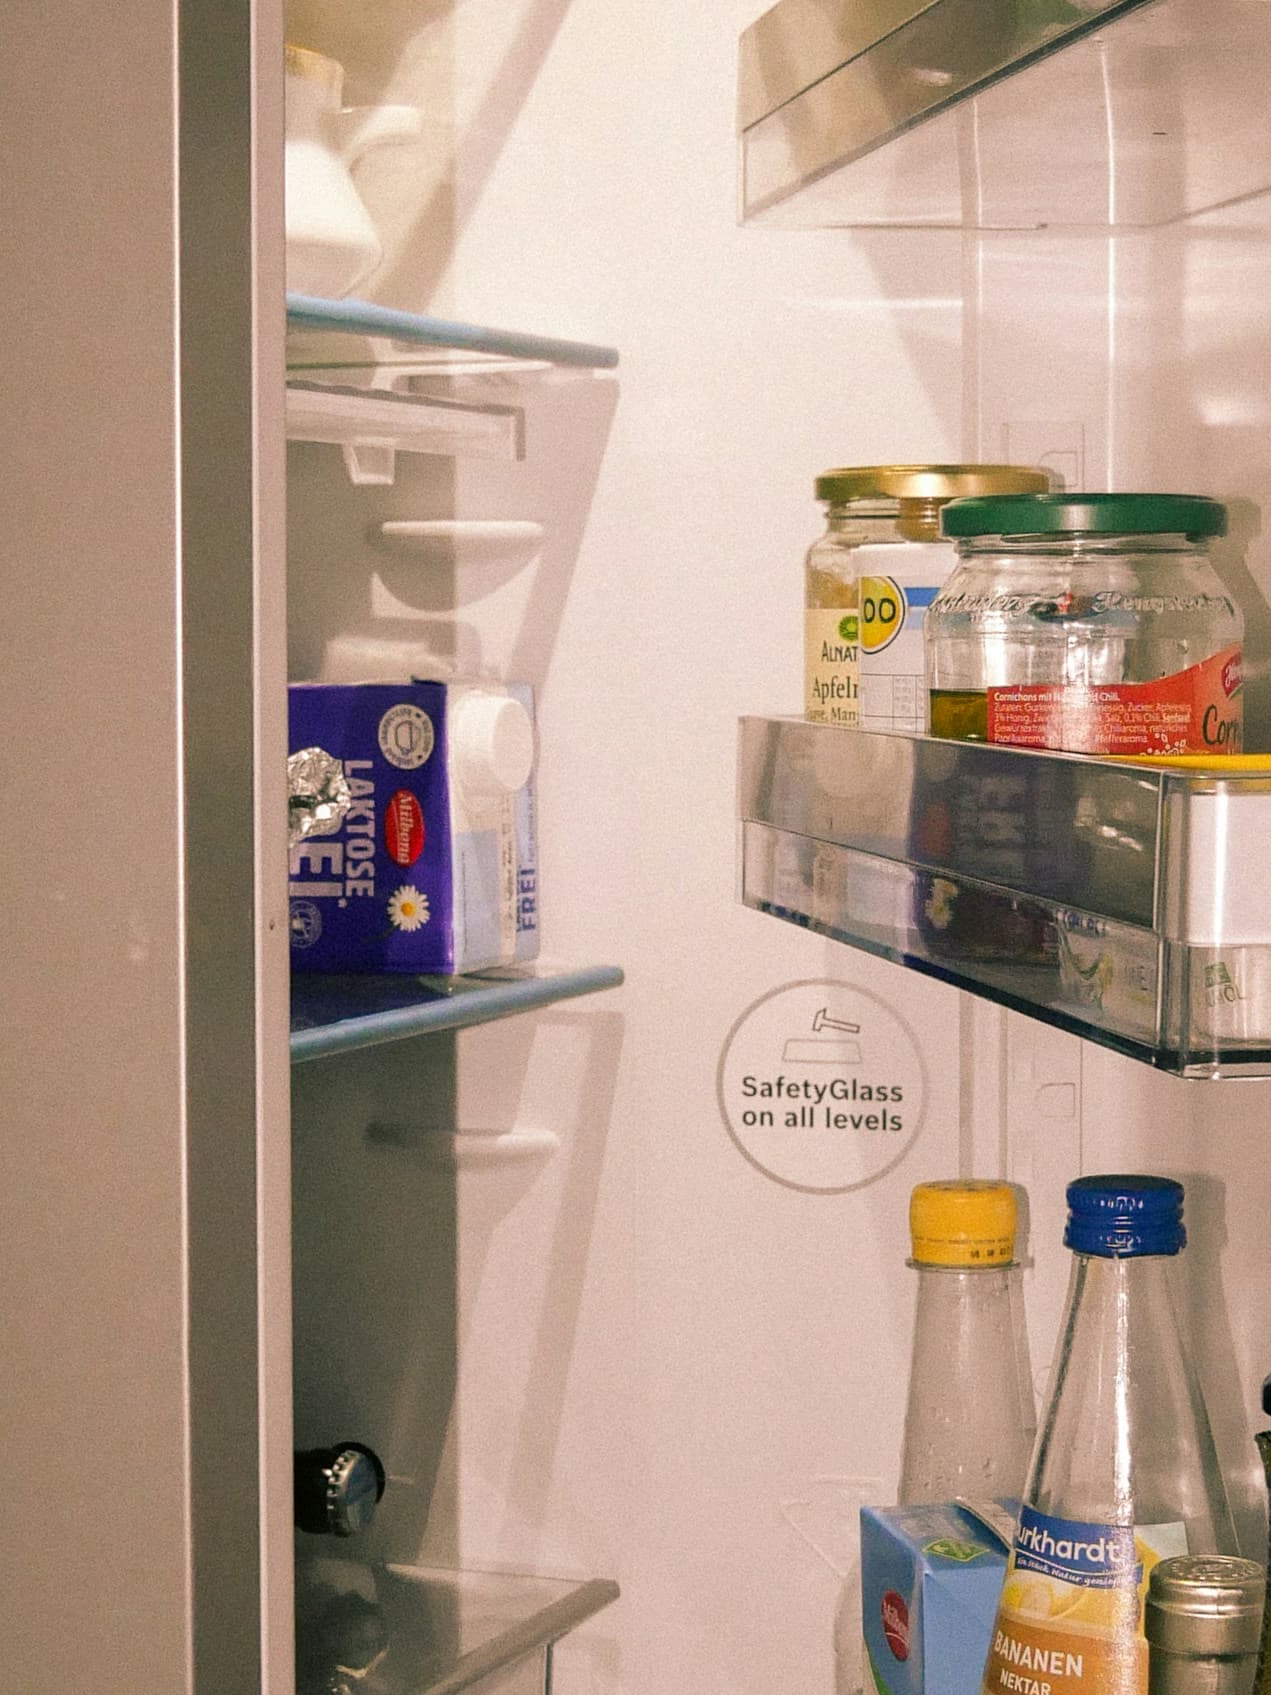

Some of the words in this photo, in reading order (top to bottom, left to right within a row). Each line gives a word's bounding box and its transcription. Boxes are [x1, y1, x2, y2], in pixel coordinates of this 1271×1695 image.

[994, 692, 1037, 702] Cornichons
[345, 760, 376, 897] LAKTOSE
[396, 793, 412, 865] Milbona
[742, 1075, 903, 1104] SafetyGlass
[742, 1109, 774, 1126] on
[784, 1106, 814, 1128] all
[826, 1107, 903, 1131] levels
[1017, 1526, 1121, 1563] urkhardt
[1051, 1568, 1082, 1584] Natur
[994, 1630, 1083, 1678] BANANEN
